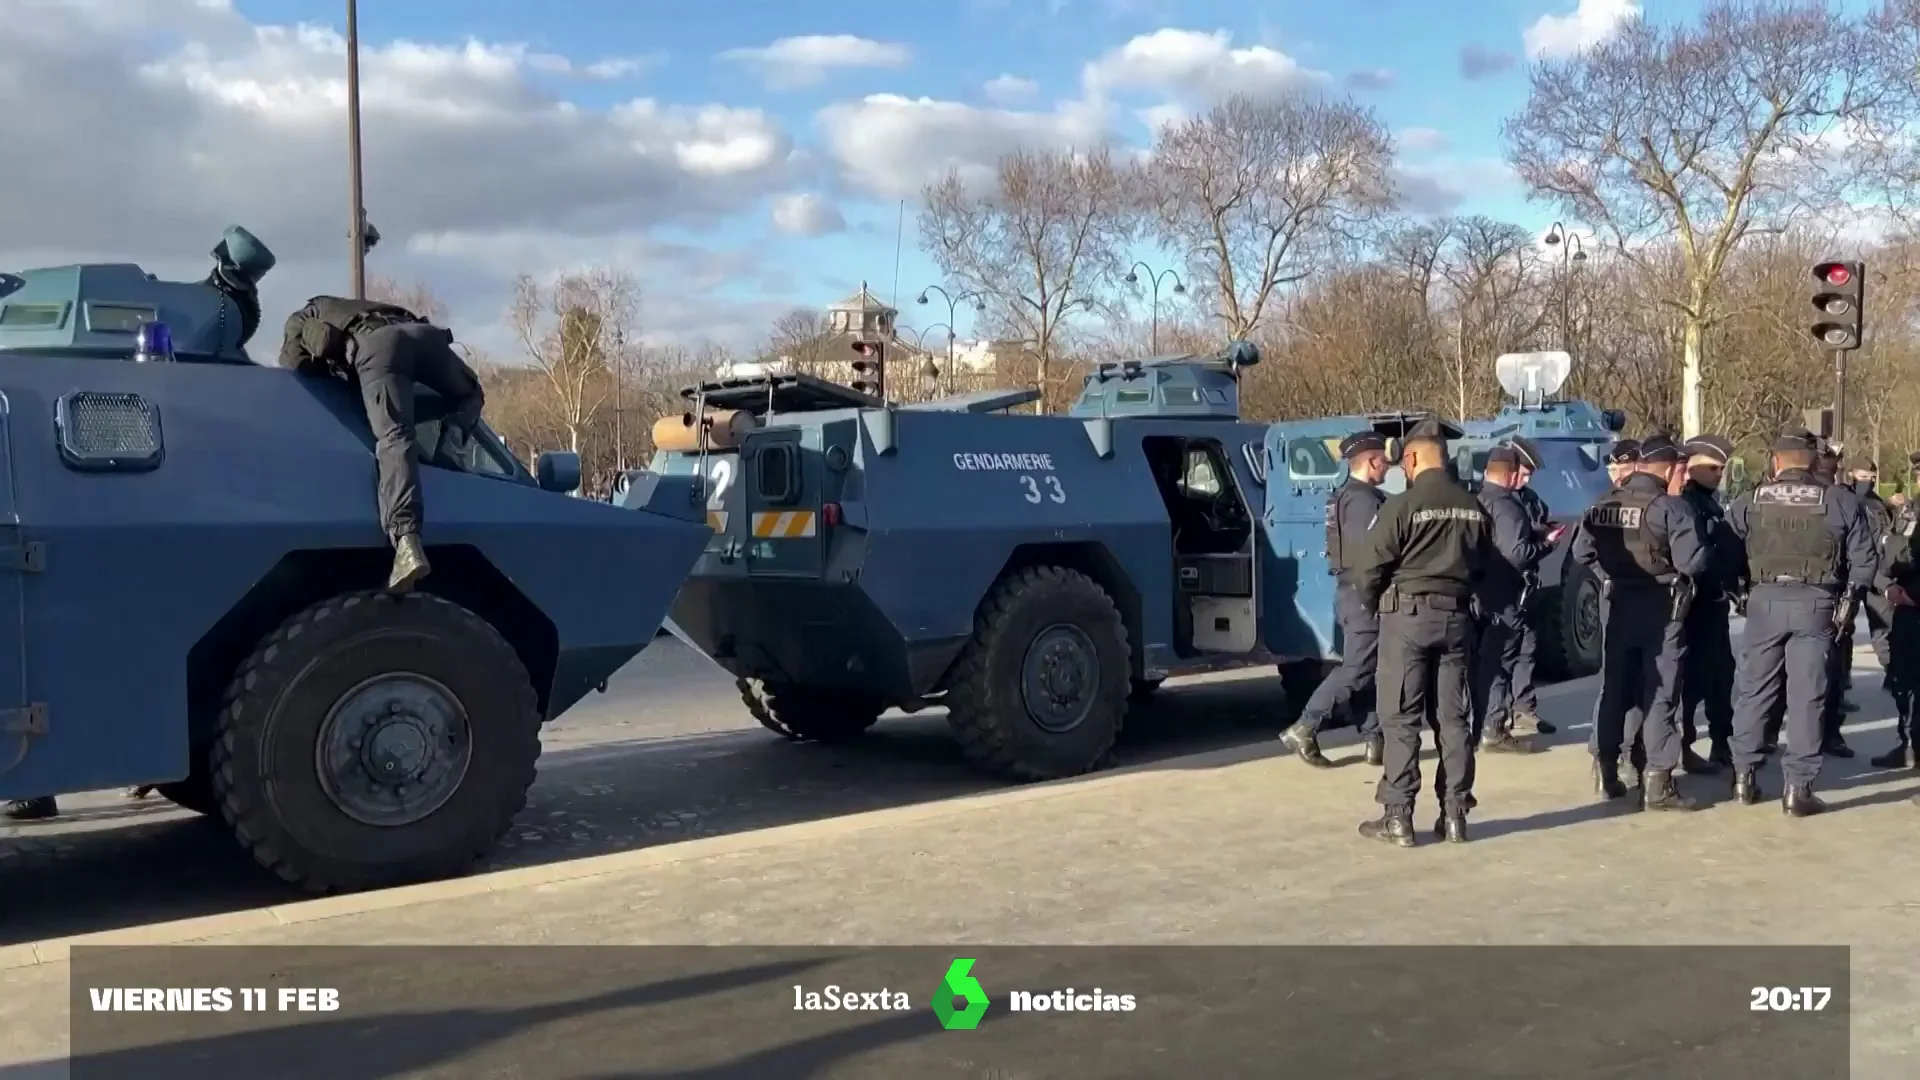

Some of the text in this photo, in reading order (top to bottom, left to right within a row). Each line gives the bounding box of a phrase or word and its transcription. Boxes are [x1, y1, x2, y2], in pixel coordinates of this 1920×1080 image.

[953, 453, 1055, 471] GENDARMERIE
[1759, 484, 1820, 498] POLICE
[1591, 507, 1638, 526] POLICE
